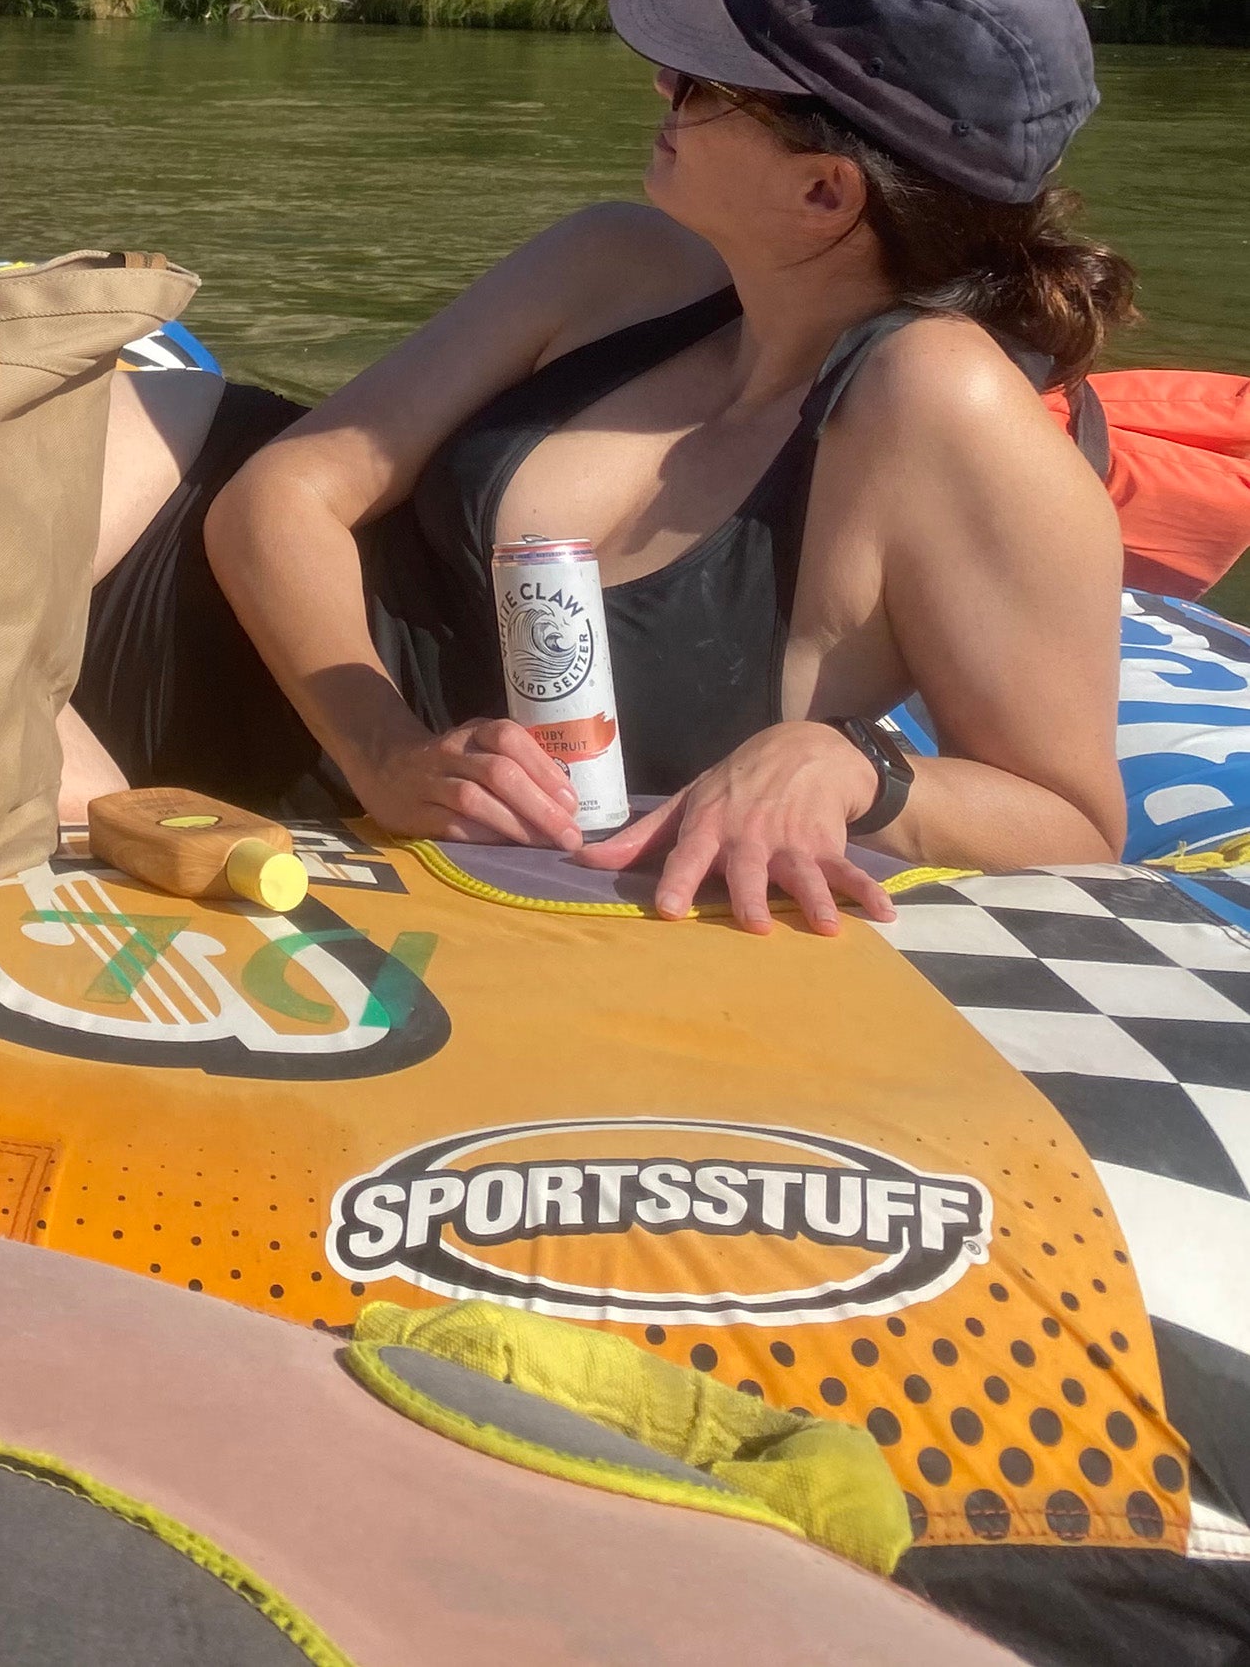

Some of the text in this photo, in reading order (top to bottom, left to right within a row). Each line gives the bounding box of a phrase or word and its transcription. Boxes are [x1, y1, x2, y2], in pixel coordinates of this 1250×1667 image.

[499, 582, 584, 658] WHITE CLAW
[512, 633, 589, 696] HARD SELTZER
[534, 731, 565, 741] RUBY
[346, 1161, 972, 1261] SPORTSSTUFF
